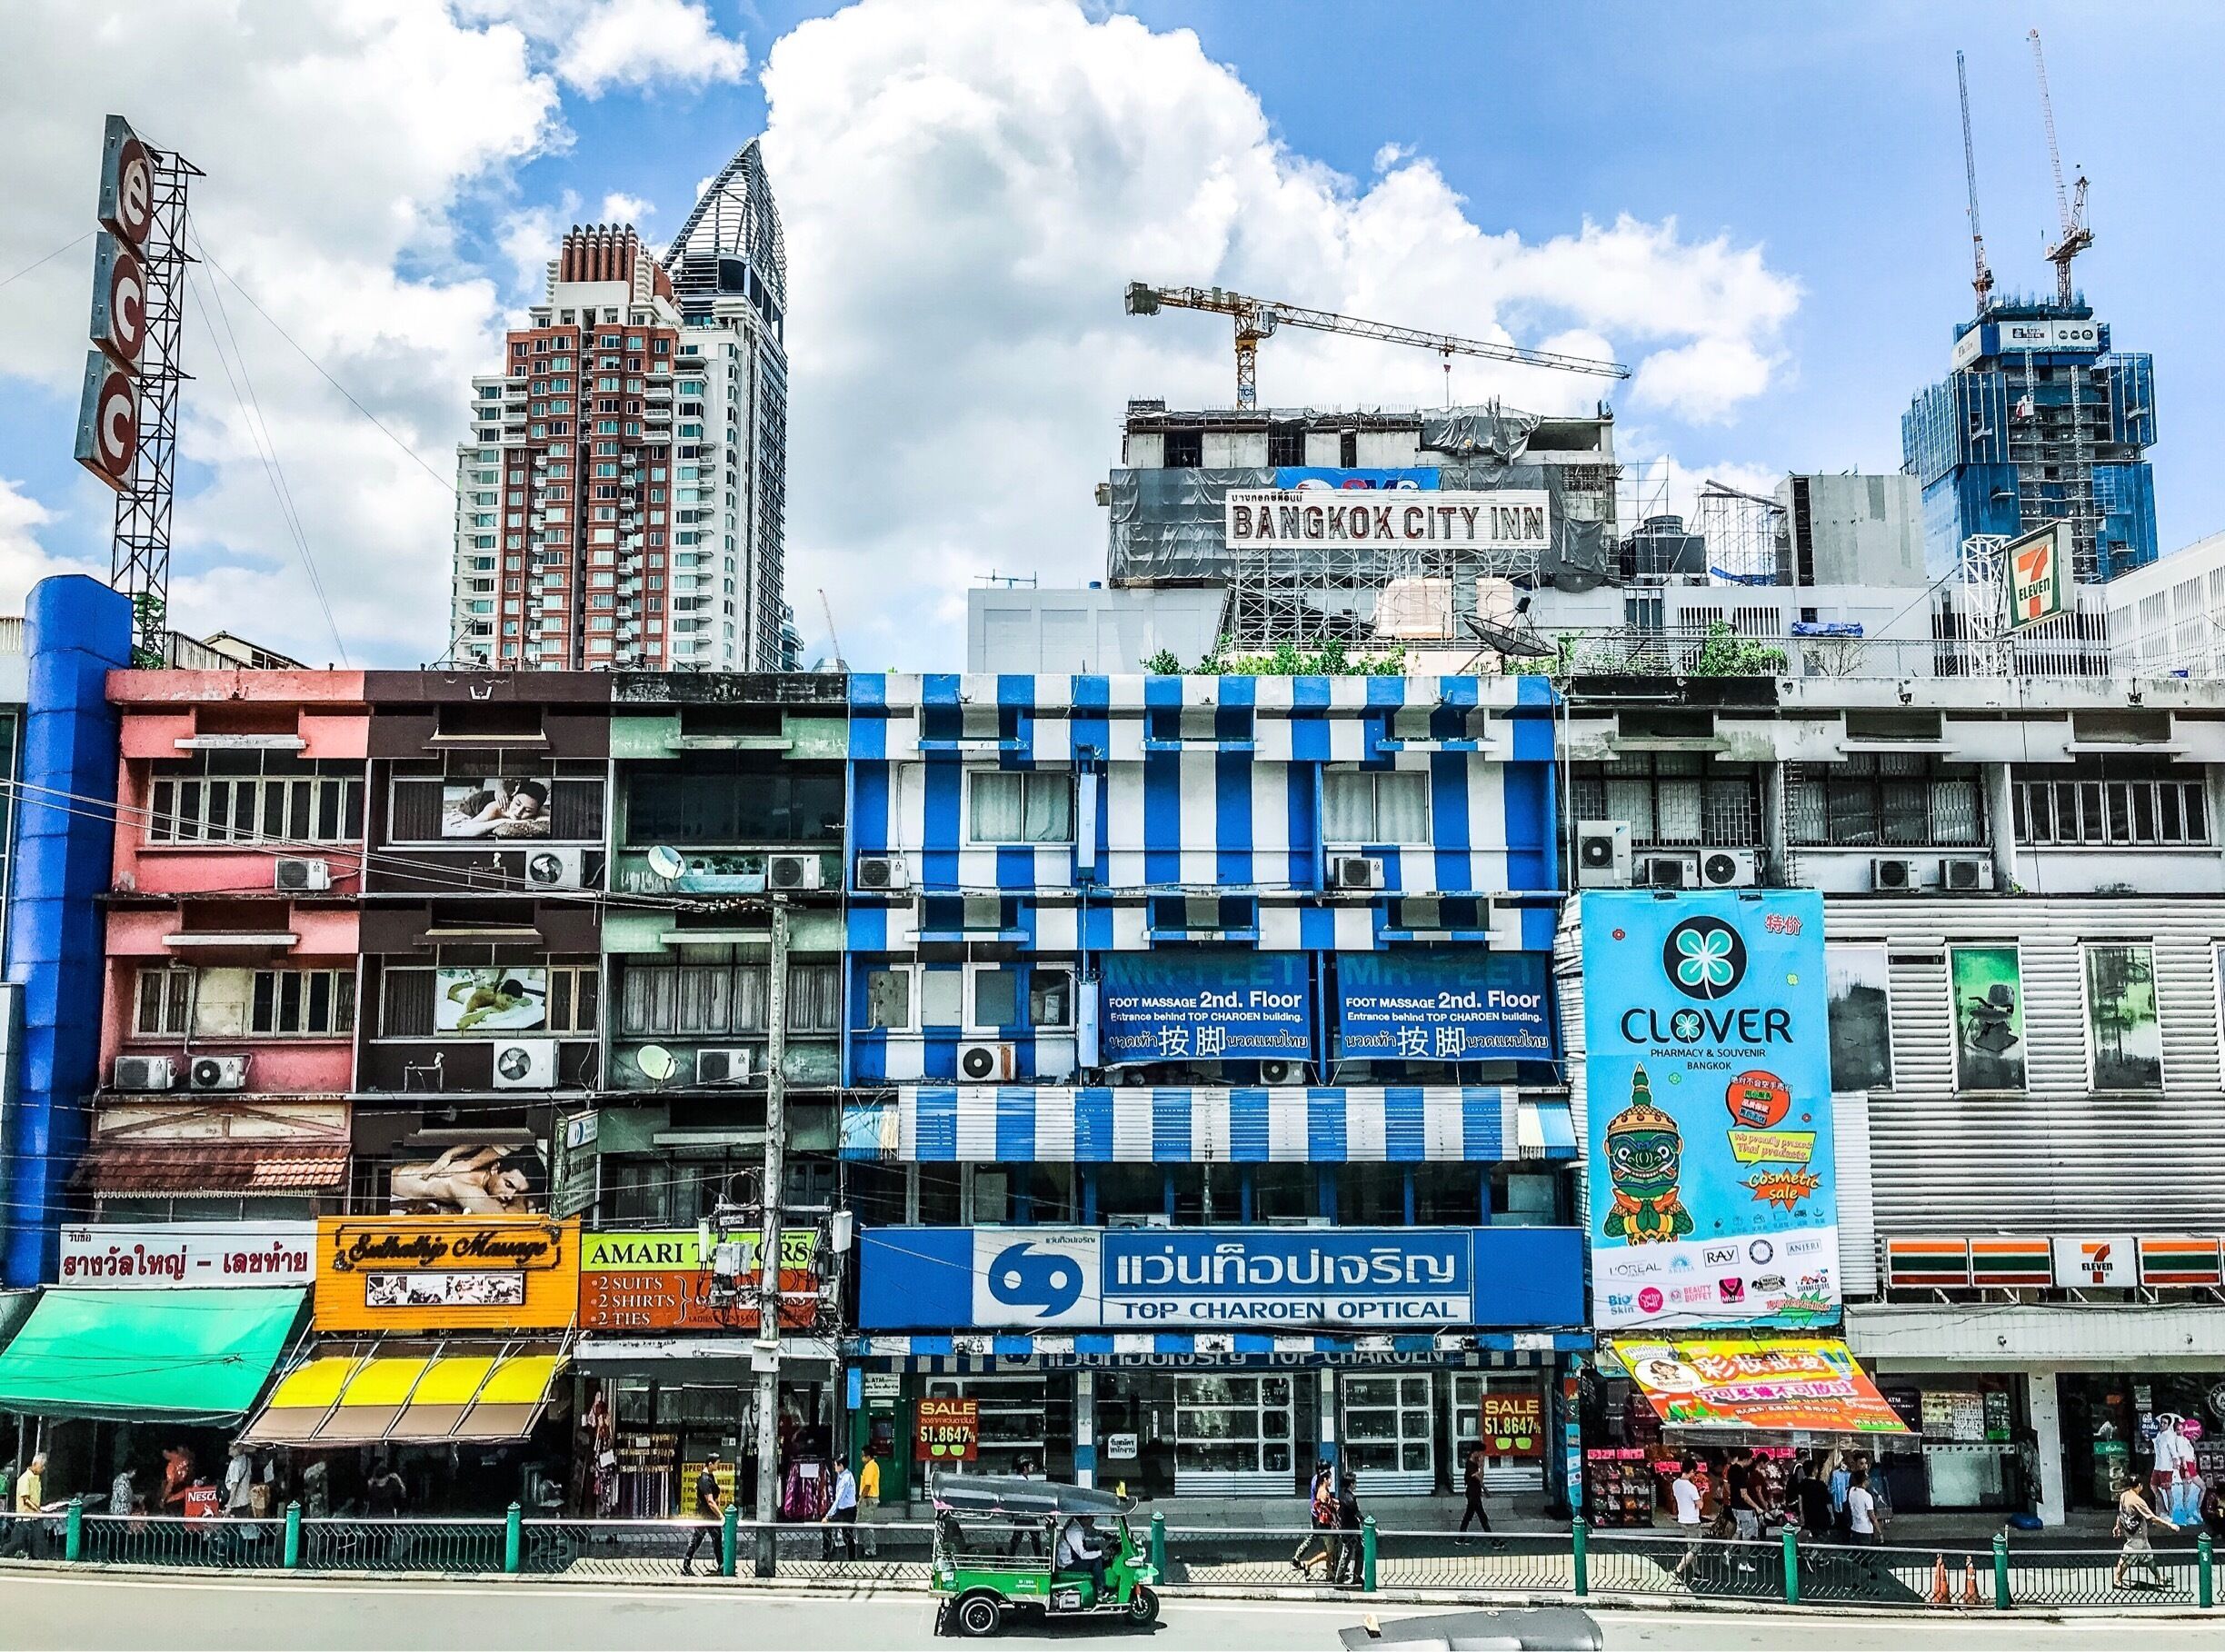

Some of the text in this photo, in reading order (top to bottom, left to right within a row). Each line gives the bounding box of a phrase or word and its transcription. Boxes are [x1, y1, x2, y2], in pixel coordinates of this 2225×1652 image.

[1240, 388, 1254, 396] TC5
[1232, 505, 1543, 540] BANGKOK CITY INN
[1109, 990, 1302, 1008] FOOT MASSAGE 2nd. Floor
[1346, 990, 1541, 1009] FOOT MASSAGE 2nd. Floor
[1111, 1012, 1303, 1022] Entrance behind TOP CHAROEN building.
[1347, 1011, 1542, 1023] Entrance behind TOP CHAROEN building.
[1621, 1008, 1794, 1044] CLOVER
[1109, 1031, 1158, 1049] นวดเท้า
[1226, 1029, 1308, 1049] นวดแผนไทย
[1345, 1031, 1396, 1049] นวดเท้า
[1465, 1029, 1549, 1049] นวดแผนไทย
[1651, 1049, 1766, 1058] PHARMACY & SOUVENIR
[1687, 1061, 1731, 1070] BANGKOK
[1749, 1173, 1819, 1189] Cosmetic
[1769, 1185, 1798, 1199] sale
[64, 1244, 187, 1280] รางวัลใหญ่
[223, 1241, 308, 1273] เลขท้าย
[591, 1243, 683, 1264] AMARI
[1707, 1249, 1734, 1263] RAY
[1117, 1243, 1455, 1284] แว่นท็อปเจริญ
[599, 1276, 663, 1290] 2 SUITS
[1683, 1285, 1711, 1295] BEAUTY
[598, 1294, 675, 1309] 2 SHIRTS
[1684, 1292, 1711, 1302] BUFFET
[1120, 1301, 1458, 1319] TOP CHAROEN OPTICAL
[598, 1312, 650, 1325] 2 TIES
[1694, 1354, 1825, 1379] 彩妆批发
[920, 1402, 976, 1415] SALE
[1484, 1400, 1540, 1415] SALE
[1484, 1417, 1542, 1435] 51.8647%
[920, 1426, 975, 1443] 51.8647%
